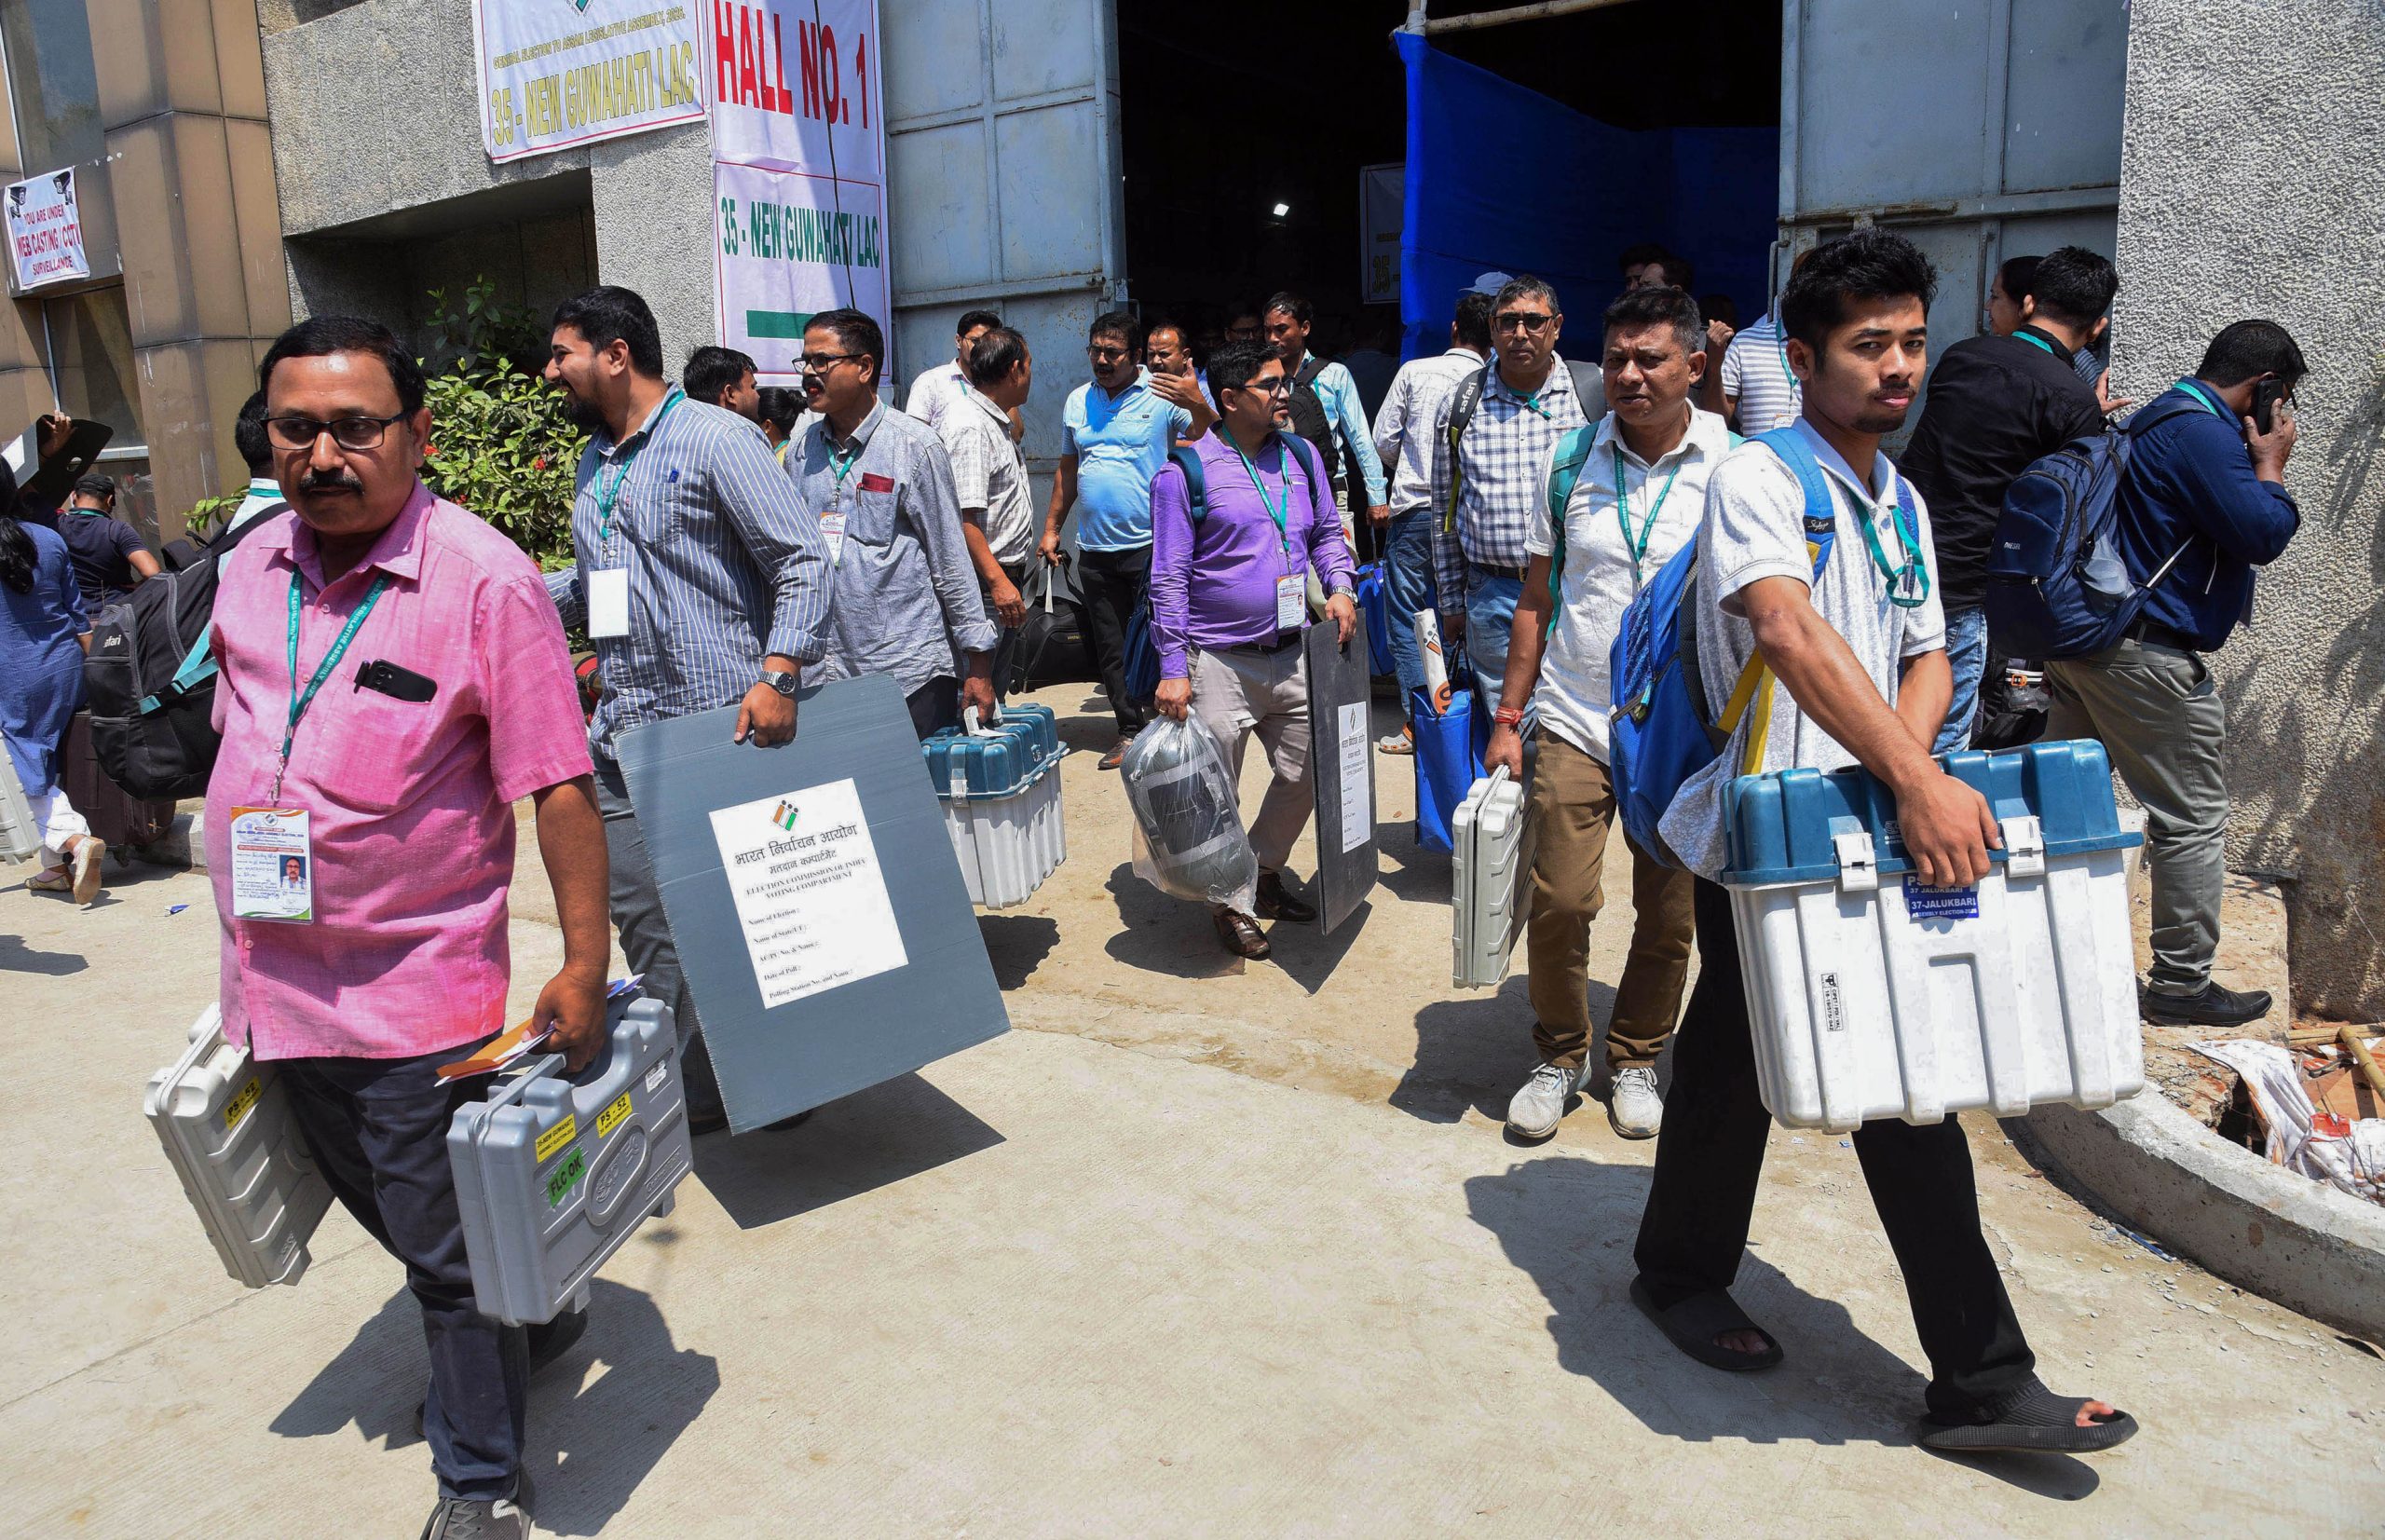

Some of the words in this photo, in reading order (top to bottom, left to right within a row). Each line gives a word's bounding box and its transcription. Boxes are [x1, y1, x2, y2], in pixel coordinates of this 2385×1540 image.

[492, 49, 521, 70] GENERAL
[521, 42, 552, 62] ELECTION
[552, 39, 561, 53] TO
[562, 33, 585, 50] ASSAM
[585, 20, 627, 45] LEGISLATIVE
[627, 10, 666, 34] ASSEMBLY,
[714, 0, 794, 116] HALL
[798, 19, 850, 126] NO.
[855, 33, 868, 129] 1
[491, 88, 513, 146] 35
[525, 74, 562, 138] NEW
[564, 50, 655, 129] GUWAHATI
[656, 40, 695, 108] LAC
[23, 211, 35, 225] YOU
[36, 209, 47, 223] ARE
[47, 204, 65, 220] UNDER
[16, 235, 33, 258] WEB
[32, 228, 59, 256] CASTING
[62, 223, 81, 248] CCTV
[721, 197, 739, 256] 35
[750, 200, 782, 260] NEW
[784, 205, 852, 266] GUWAHATI
[857, 214, 879, 269] LAC
[33, 255, 74, 276] SURVEILLANCE
[1373, 254, 1390, 293] 35
[1459, 382, 1478, 414] safari
[103, 634, 122, 648] afari
[735, 848, 766, 865] भारत
[769, 835, 816, 857] निर्वाचन
[820, 825, 857, 843] आयोग
[745, 879, 784, 895] ELECTION
[785, 866, 834, 885] COMMISSION
[769, 859, 798, 875] मतदान
[796, 871, 852, 891] COMPARTMENT
[1911, 897, 1976, 909] 37-JALUKBARI
[227, 1100, 238, 1116] PS
[245, 1082, 258, 1097] 52
[600, 1111, 611, 1126] PS
[617, 1097, 627, 1111] 52
[551, 1171, 567, 1196] FLC
[568, 1154, 582, 1177] OK
